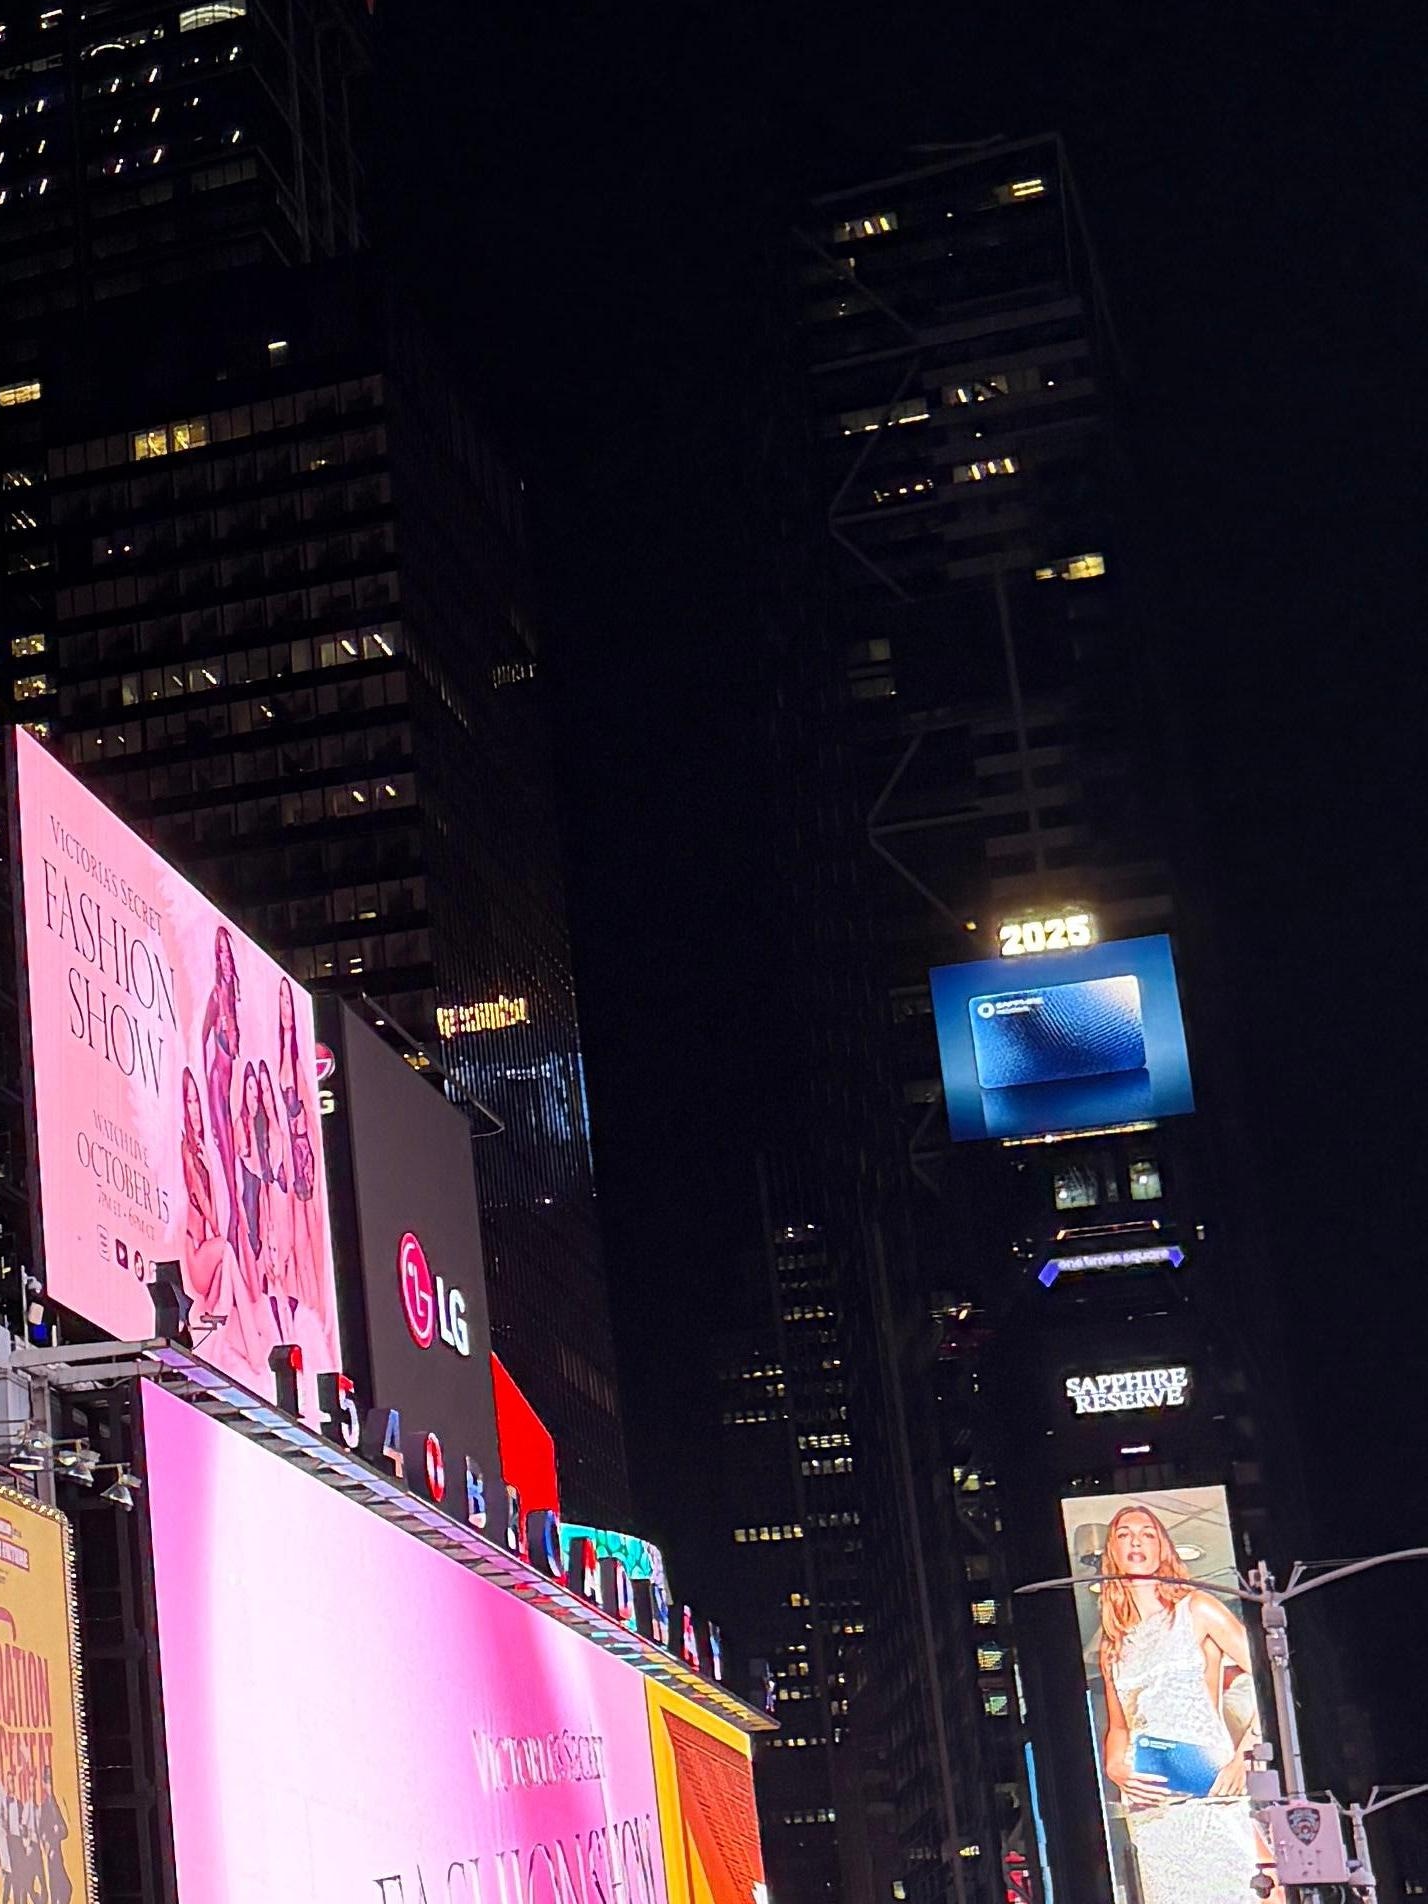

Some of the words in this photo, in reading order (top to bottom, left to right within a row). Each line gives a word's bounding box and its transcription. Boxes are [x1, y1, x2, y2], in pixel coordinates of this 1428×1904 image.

[49, 815, 118, 897] VICTORIA'S
[119, 877, 162, 937] SECRET
[42, 856, 178, 1032] FASHION
[1000, 915, 1091, 957] 2025
[68, 967, 164, 1097] SHOW
[77, 1131, 154, 1215] OCTOBER
[156, 1188, 170, 1225] 15
[435, 1275, 470, 1356] LG
[1065, 1367, 1188, 1398] SAPPHIRE
[1074, 1386, 1184, 1415] RESERVE
